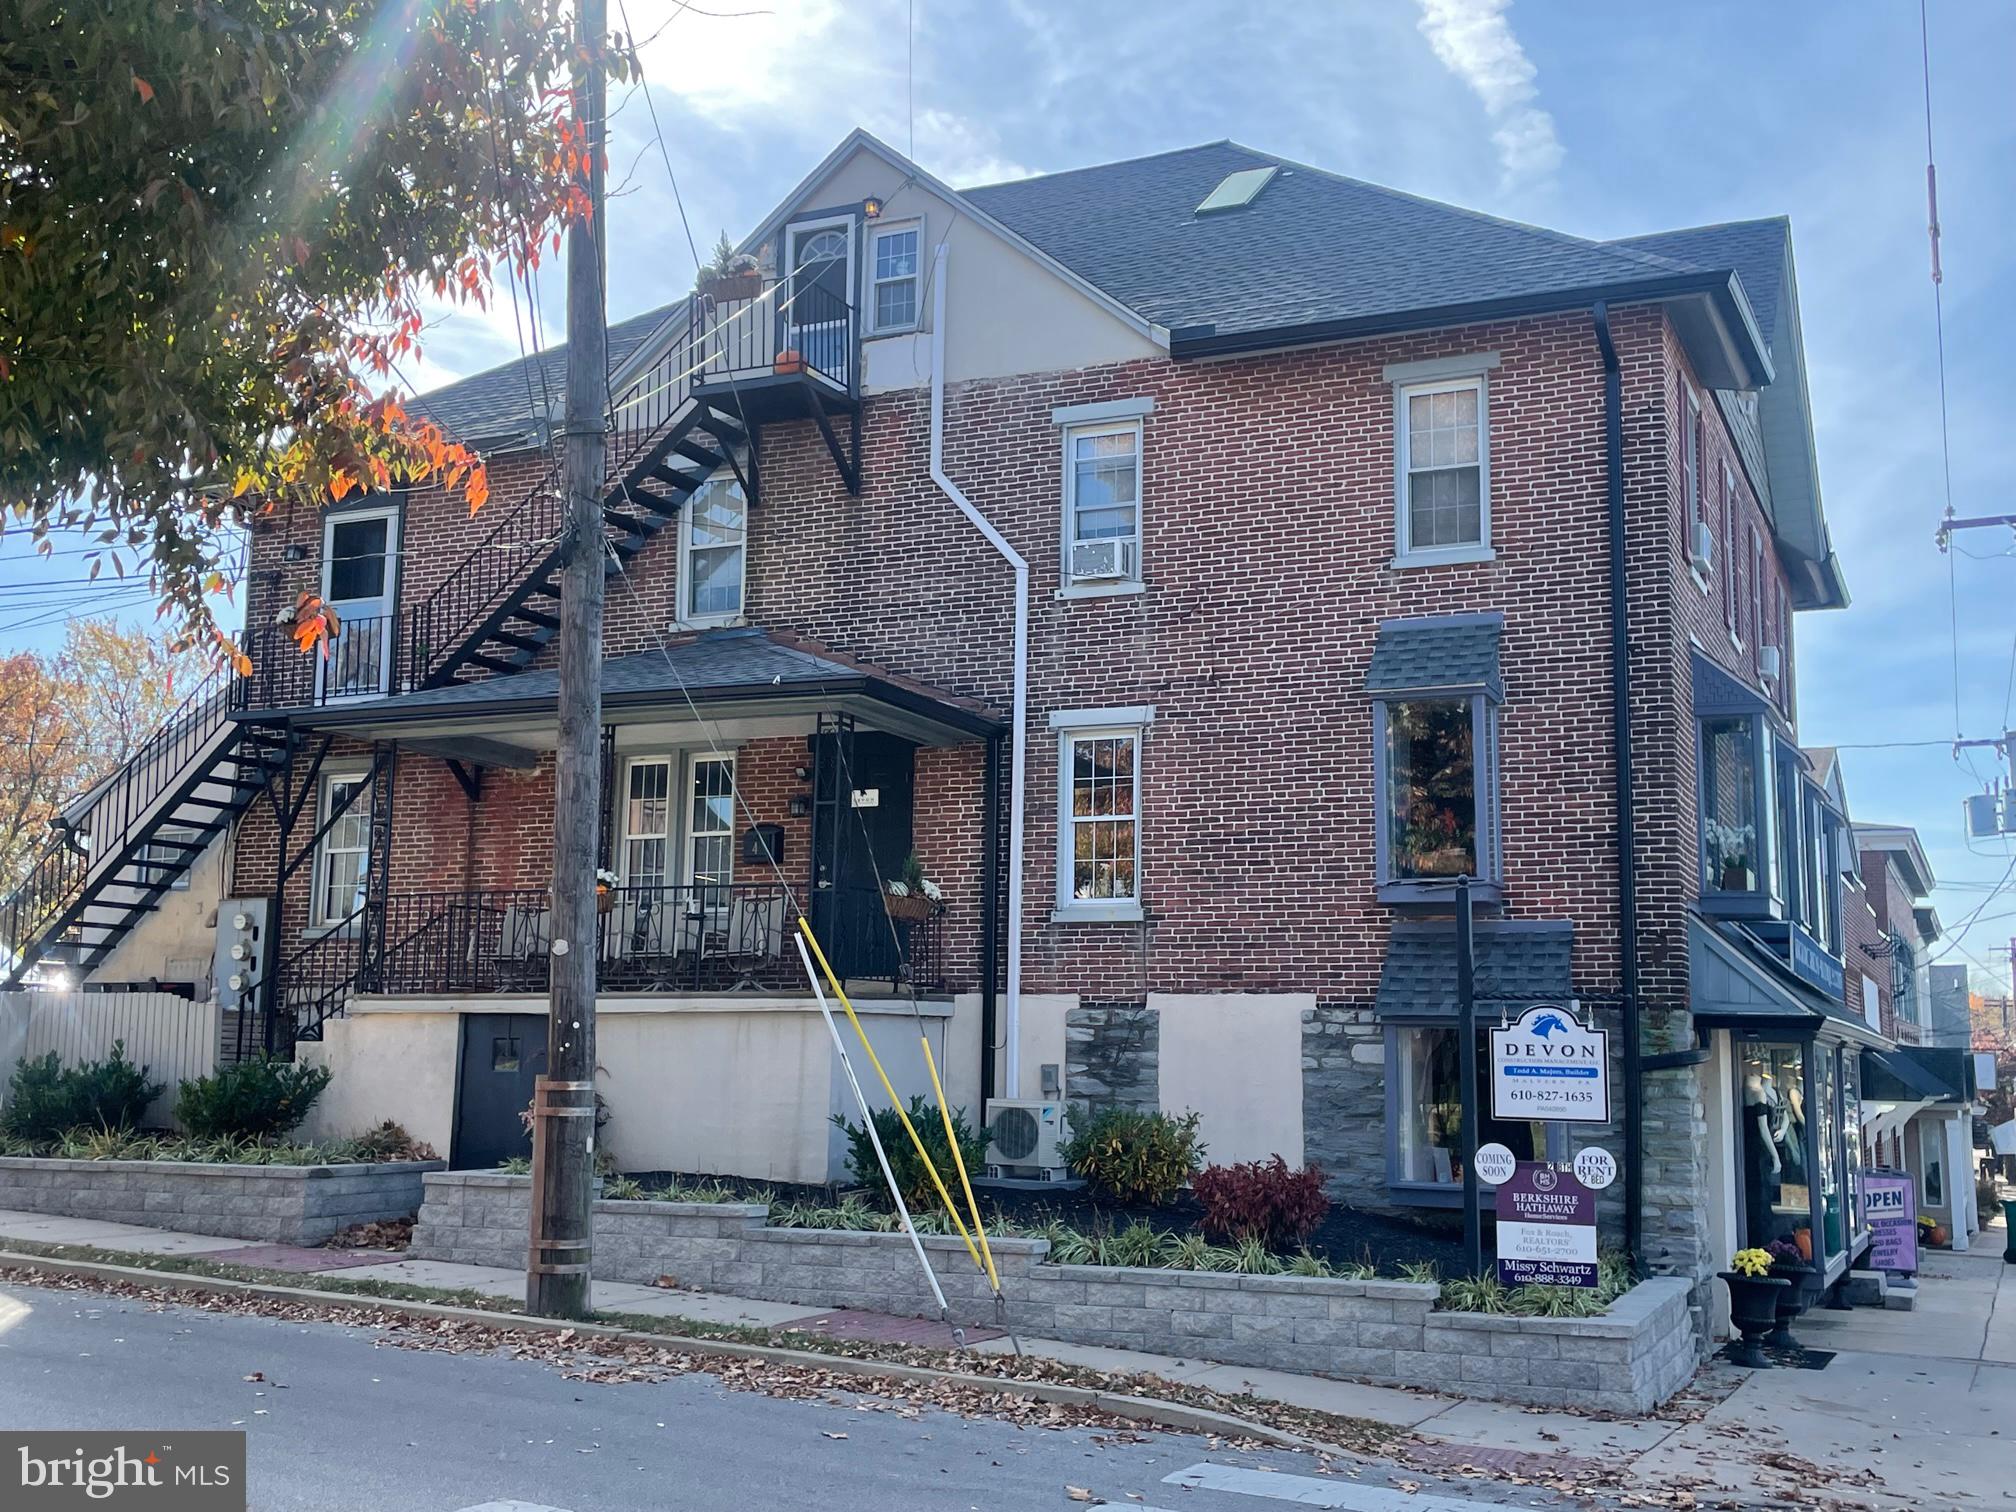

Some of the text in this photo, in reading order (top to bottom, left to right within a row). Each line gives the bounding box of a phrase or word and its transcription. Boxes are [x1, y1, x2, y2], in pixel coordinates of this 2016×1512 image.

[1505, 1043, 1595, 1058] DEVON
[1510, 1090, 1593, 1103] 610-827-1635
[1476, 1153, 1512, 1165] COMING
[1582, 1155, 1608, 1165] FOR
[1482, 1165, 1507, 1177] SOON
[1577, 1165, 1615, 1177] RENT
[1591, 1175, 1605, 1184] BED
[1512, 1192, 1579, 1205] BERKSHIRE
[1516, 1202, 1577, 1214] HATHAWAY
[1524, 1212, 1568, 1220] HomeServices
[1521, 1227, 1535, 1236] Fox
[1515, 1244, 1578, 1255] 610-651-2700
[1504, 1260, 1592, 1275] Missy Schwartz
[1514, 1272, 1582, 1285] 610-888-3349
